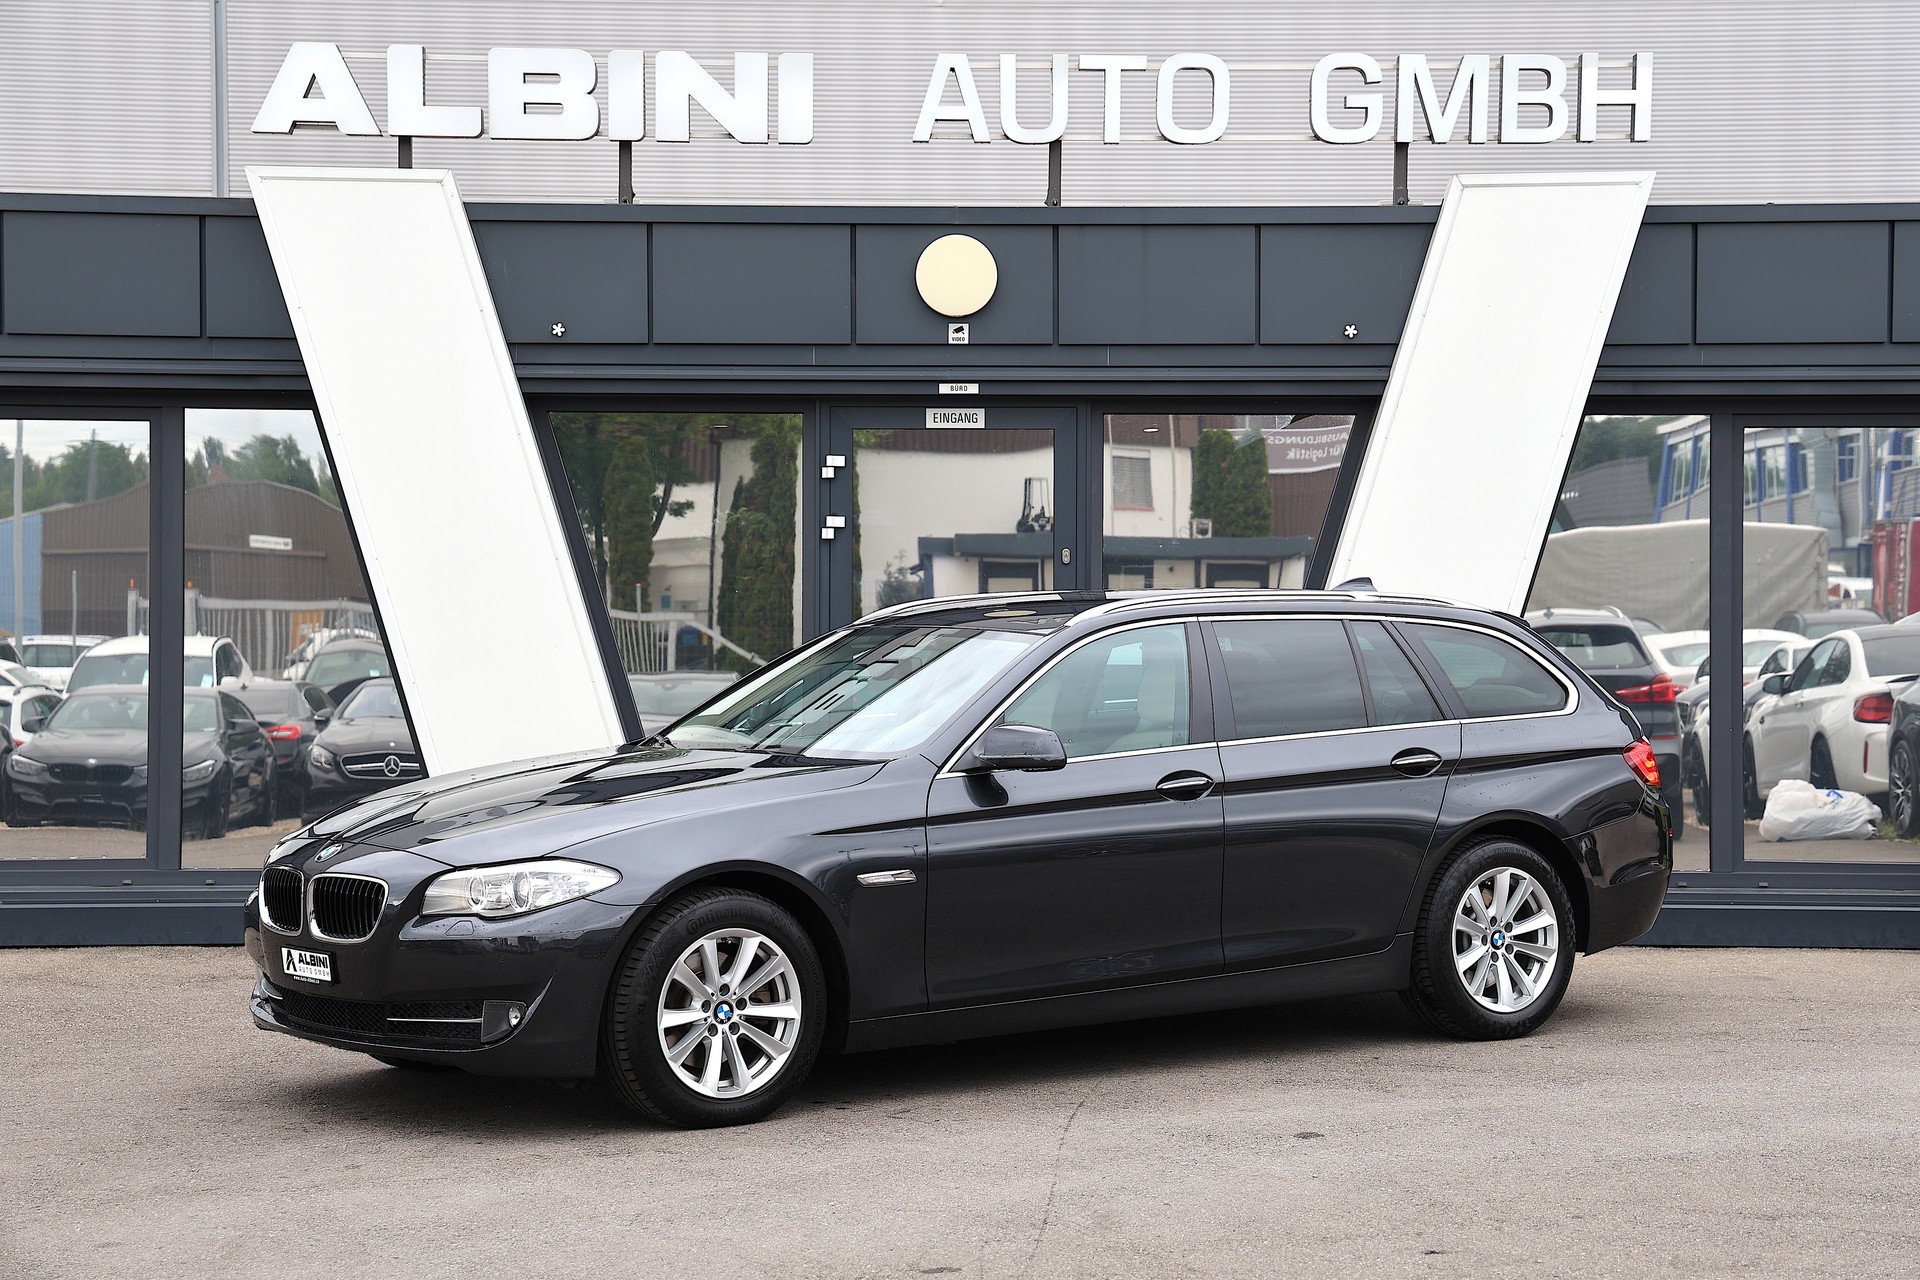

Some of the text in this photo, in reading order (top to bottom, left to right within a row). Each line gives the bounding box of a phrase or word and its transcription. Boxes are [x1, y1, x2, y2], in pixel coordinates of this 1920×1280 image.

[250, 42, 1655, 145] ALBINI AUTO GMBH
[950, 383, 968, 392] BÜRO
[933, 413, 978, 424] EINGANG
[299, 953, 329, 968] ALBINI
[299, 966, 313, 974] AUTO
